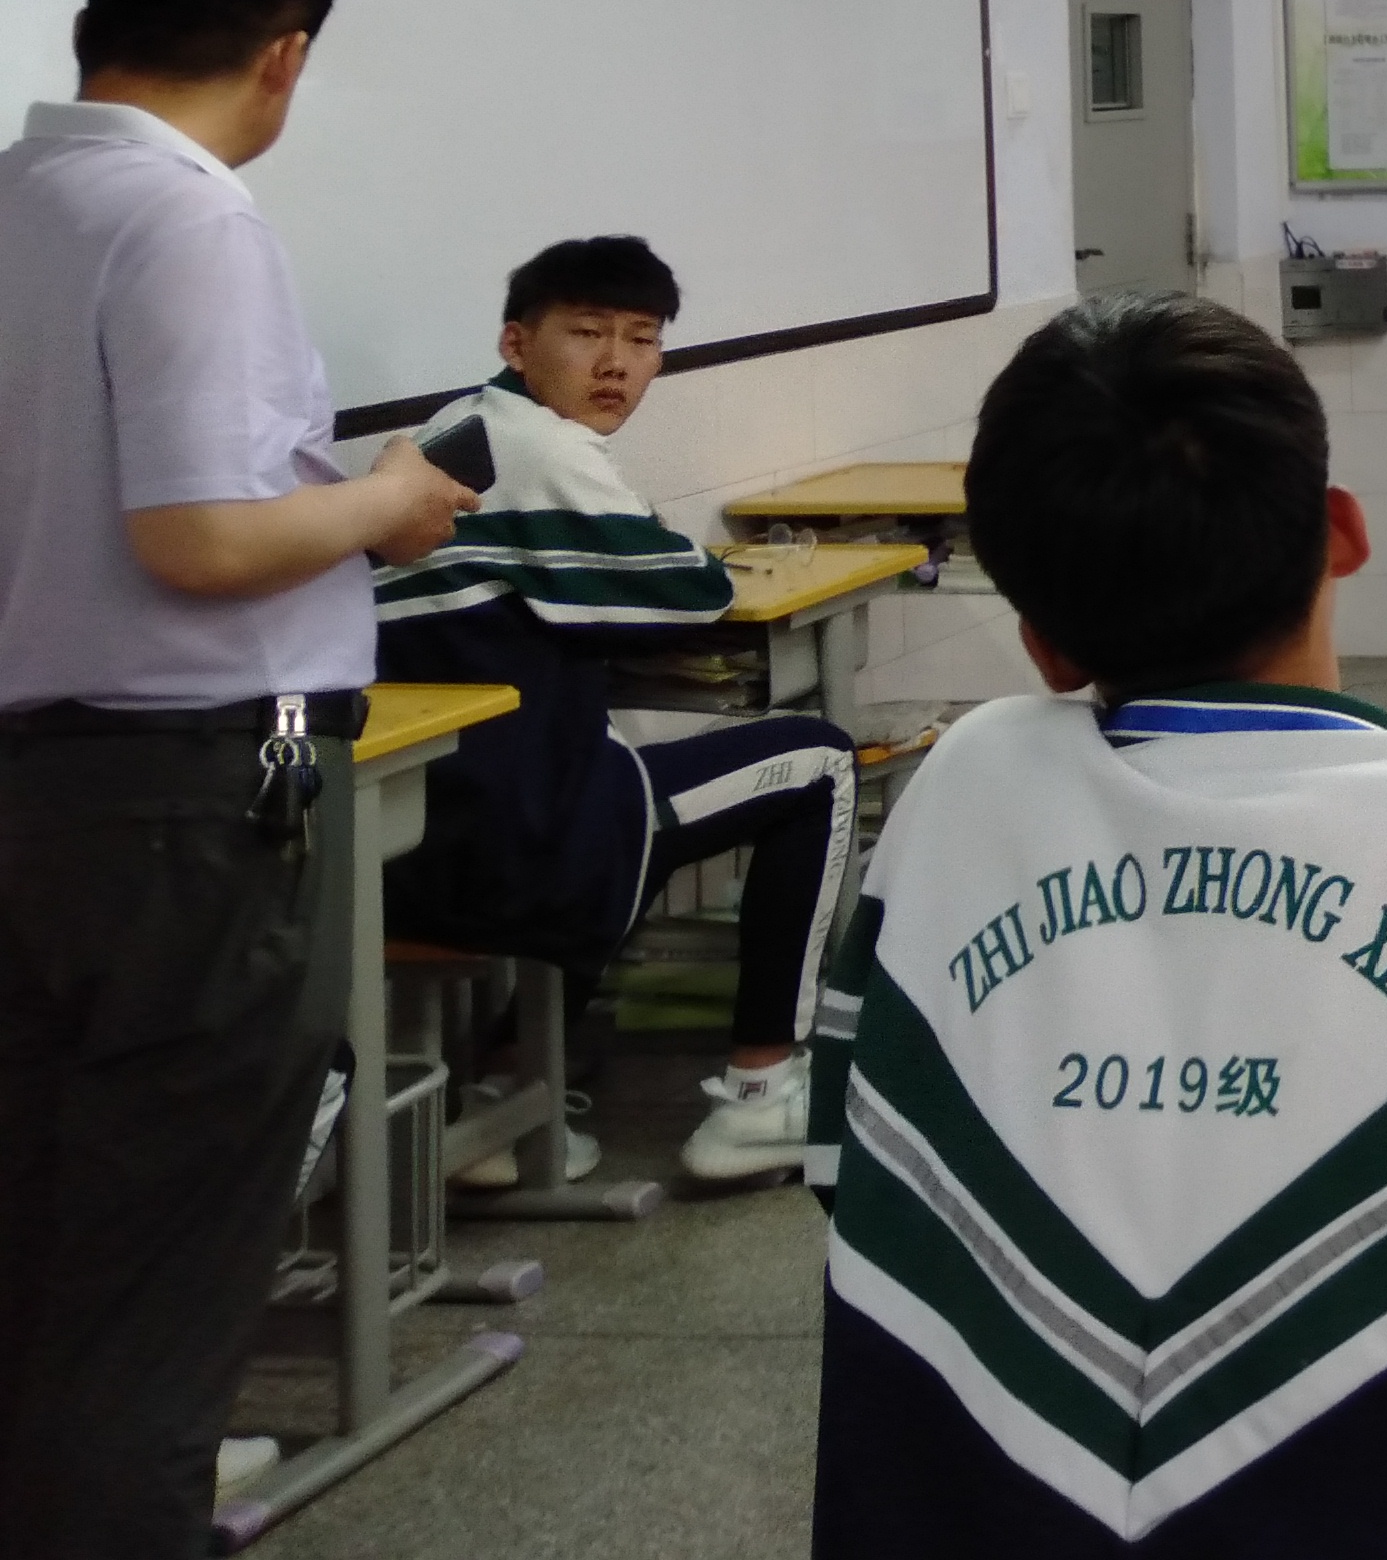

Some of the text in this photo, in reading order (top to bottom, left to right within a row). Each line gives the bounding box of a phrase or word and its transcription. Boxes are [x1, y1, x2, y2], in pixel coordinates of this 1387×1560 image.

[949, 902, 1034, 1015] ZHI
[1036, 852, 1147, 945] JIAO
[1161, 845, 1355, 943] ZHONG
[1051, 1052, 1281, 1117] 2019级
